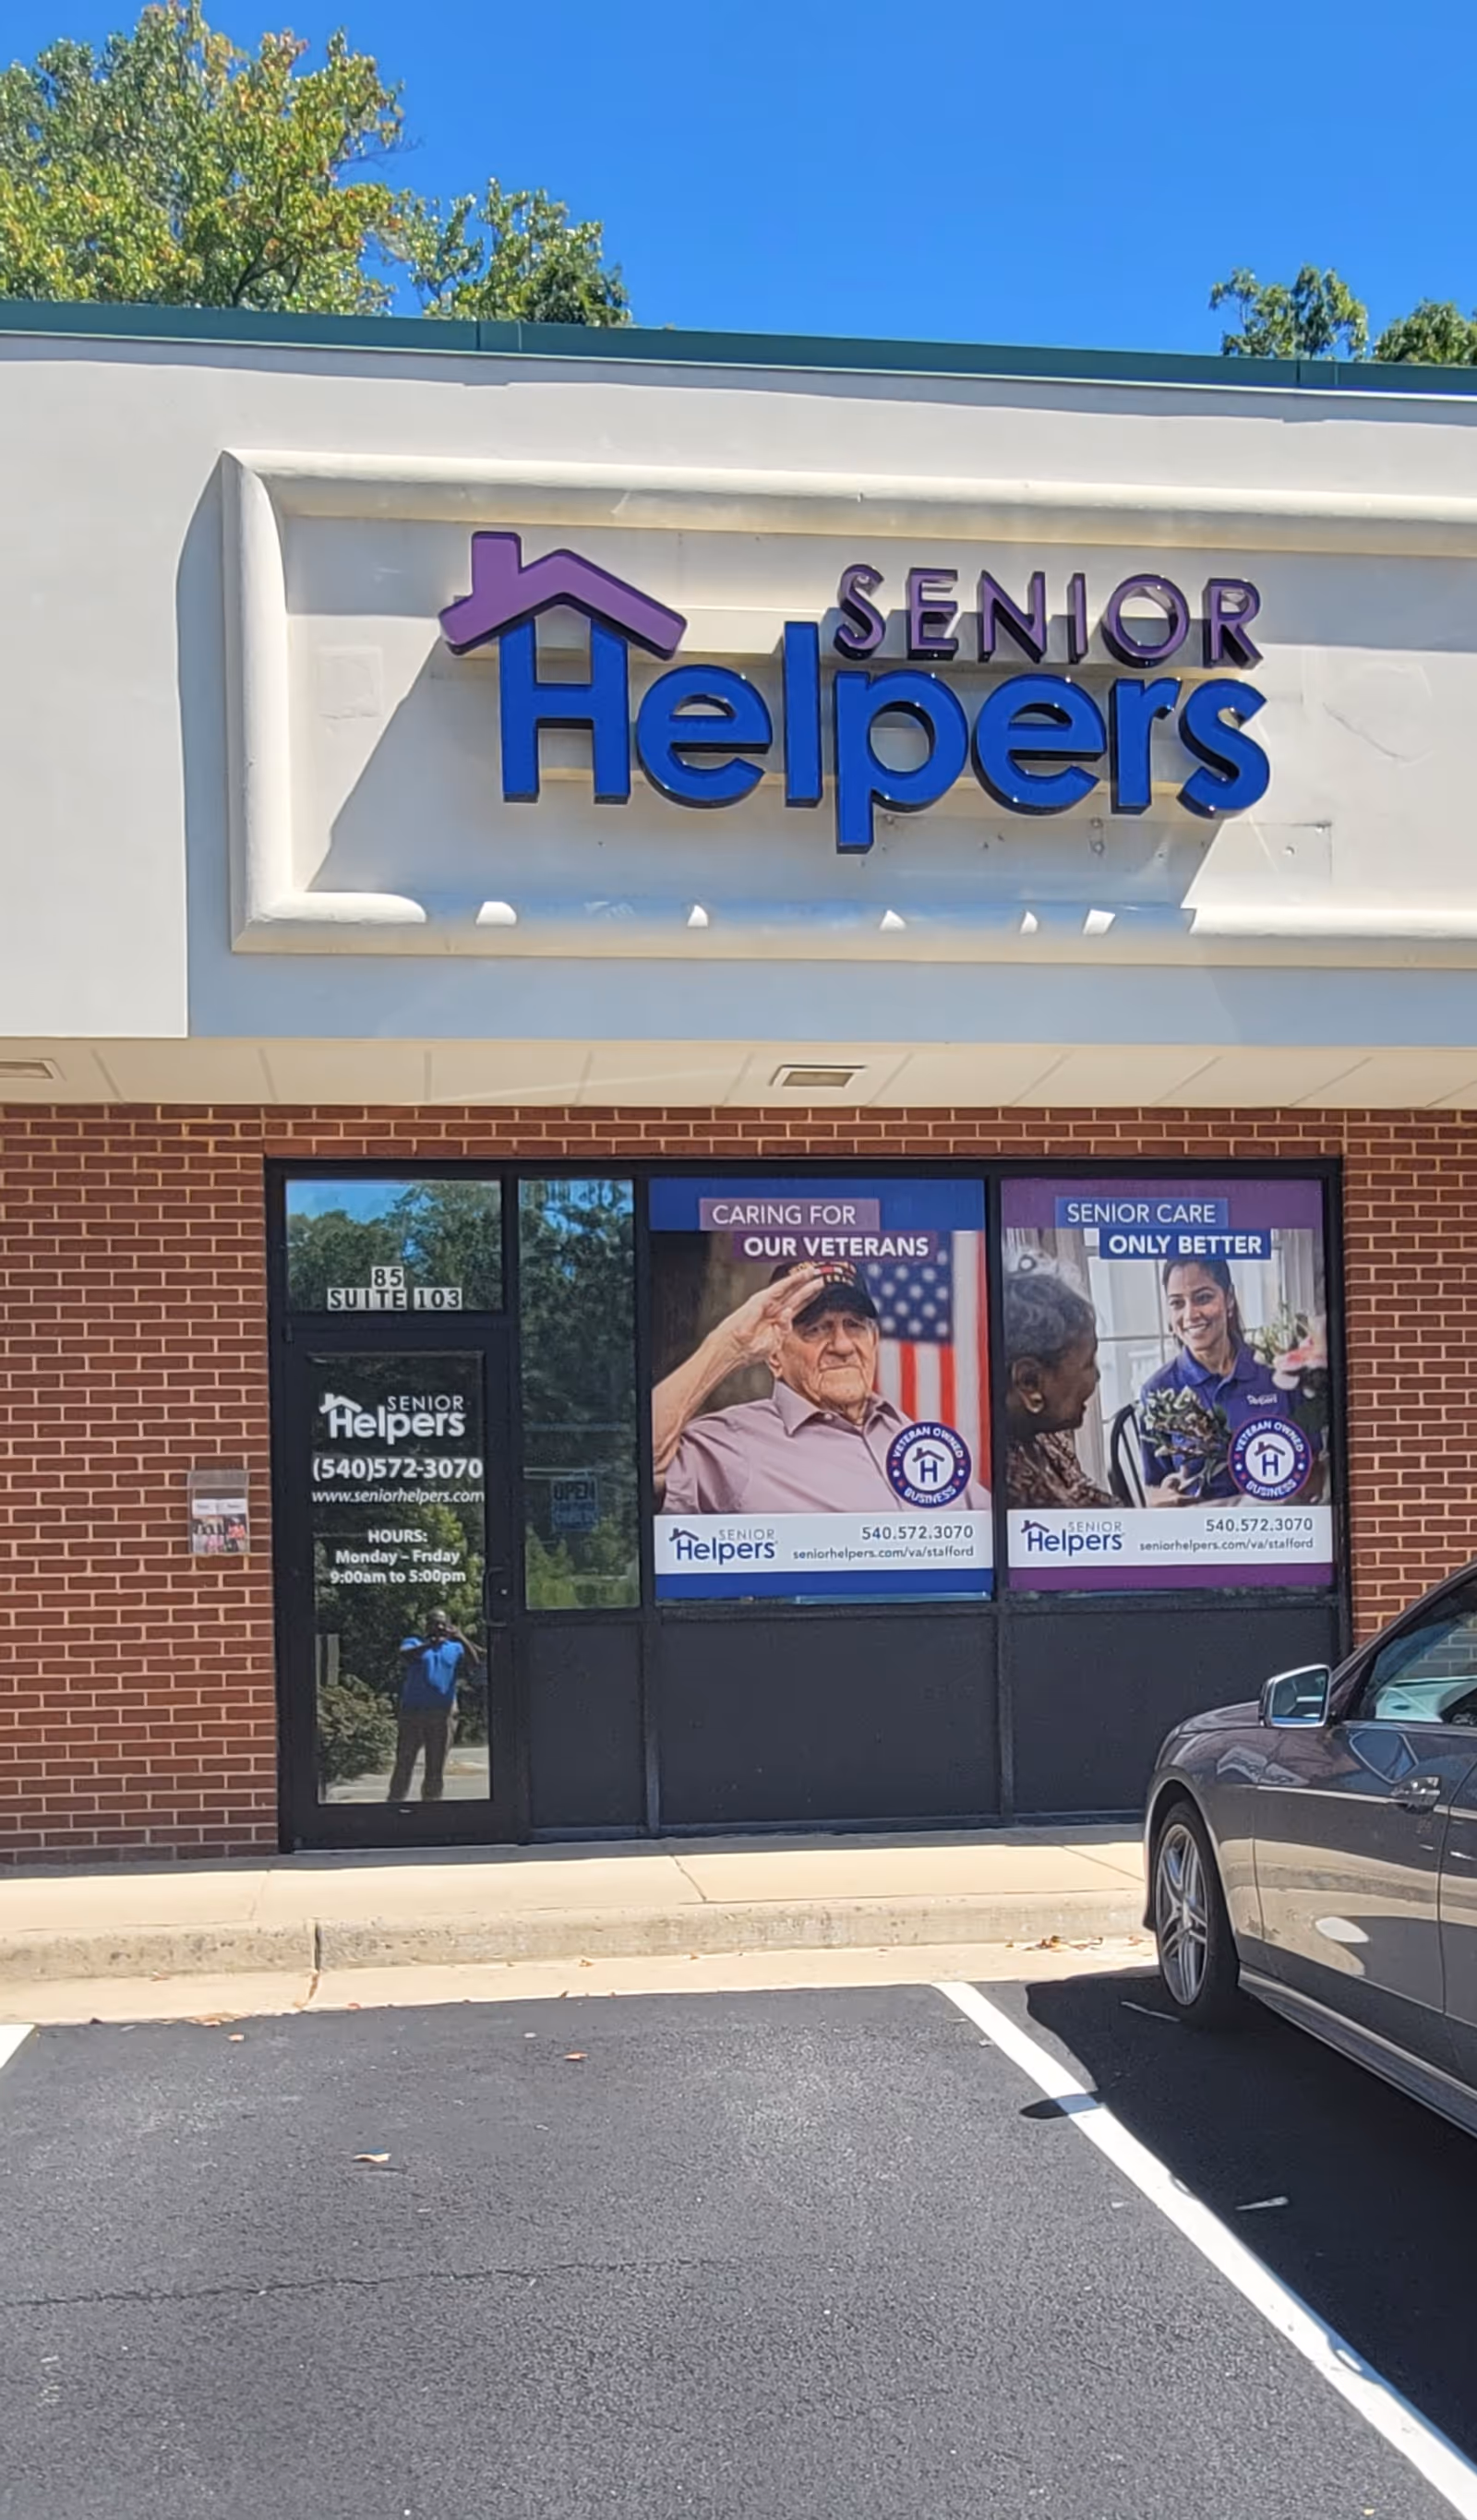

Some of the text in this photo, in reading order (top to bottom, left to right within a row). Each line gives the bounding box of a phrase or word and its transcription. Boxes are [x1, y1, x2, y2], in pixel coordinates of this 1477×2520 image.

[834, 563, 1265, 671] SENIOR
[498, 618, 1270, 855] Helpers
[712, 1204, 857, 1225] CARING FOR
[1067, 1203, 1217, 1223] SENIOR CARE
[744, 1237, 930, 1257] OUR VETERANS
[1109, 1234, 1263, 1254] ONLY BETTER
[374, 1268, 402, 1288] 85
[330, 1290, 461, 1309] SUITE 103
[387, 1395, 464, 1411] SENIOR
[330, 1405, 467, 1446] Helpers
[893, 1426, 931, 1458] VETERAN
[1235, 1421, 1271, 1452] VETERAN
[312, 1458, 484, 1482] (540)572-3070
[920, 1459, 938, 1482] H
[1262, 1454, 1279, 1477] H
[311, 1487, 485, 1506] www.seniorhelpers.com
[904, 1485, 956, 1504] BUSINESS
[1245, 1478, 1297, 1497] BUSINESS
[718, 1529, 775, 1540] SENIOR
[861, 1526, 974, 1540] 540.572.3070
[1068, 1521, 1122, 1532] SENIOR
[1206, 1518, 1314, 1532] 540.572.3070
[367, 1529, 428, 1543] HOURS:
[1027, 1530, 1123, 1556] Helpers
[1139, 1537, 1314, 1553] seniorhelpers.com/va/stafford
[335, 1549, 398, 1566] Monday
[413, 1548, 461, 1566] Friday
[676, 1539, 775, 1565] Helpers
[792, 1545, 975, 1561] seniorhelpers.com/va/stafford
[330, 1569, 467, 1585] 9:00am to 5:00pm
